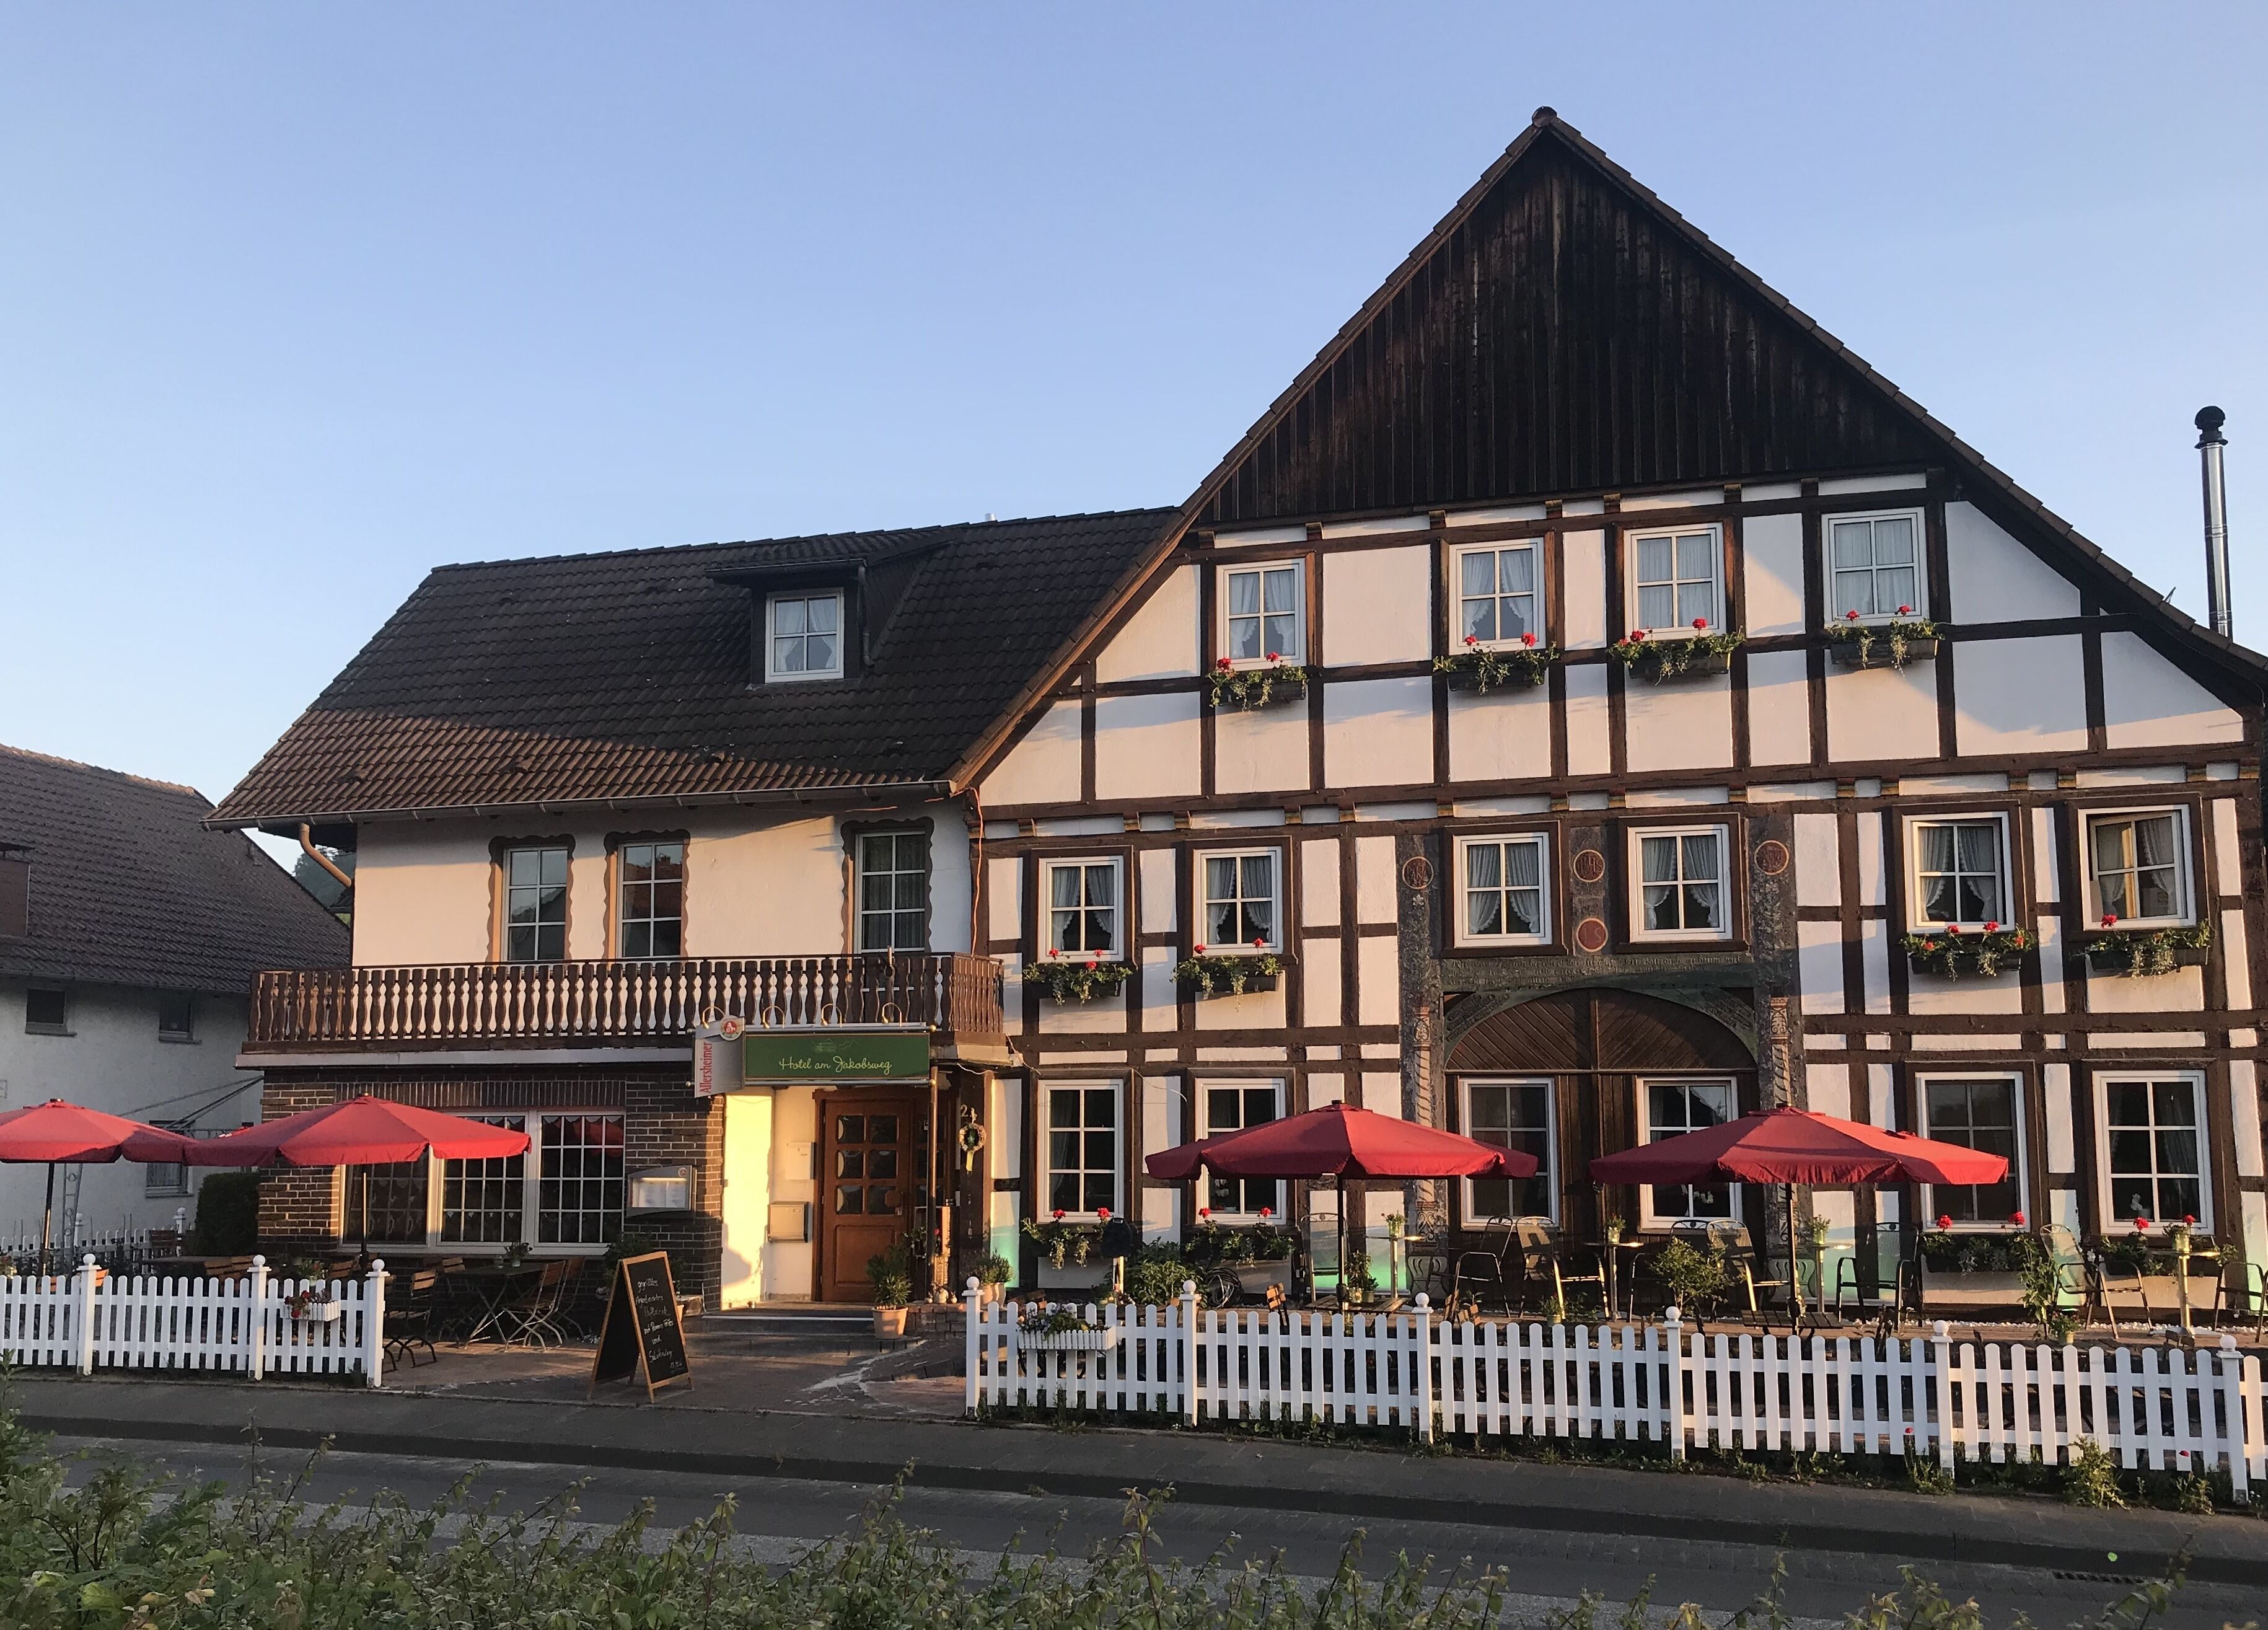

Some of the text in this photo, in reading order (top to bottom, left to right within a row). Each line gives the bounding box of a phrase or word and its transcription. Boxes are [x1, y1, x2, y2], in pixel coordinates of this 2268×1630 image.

[699, 1042, 713, 1093] Allersheimer
[779, 1055, 892, 1075] Hotel am Jakobsweg
